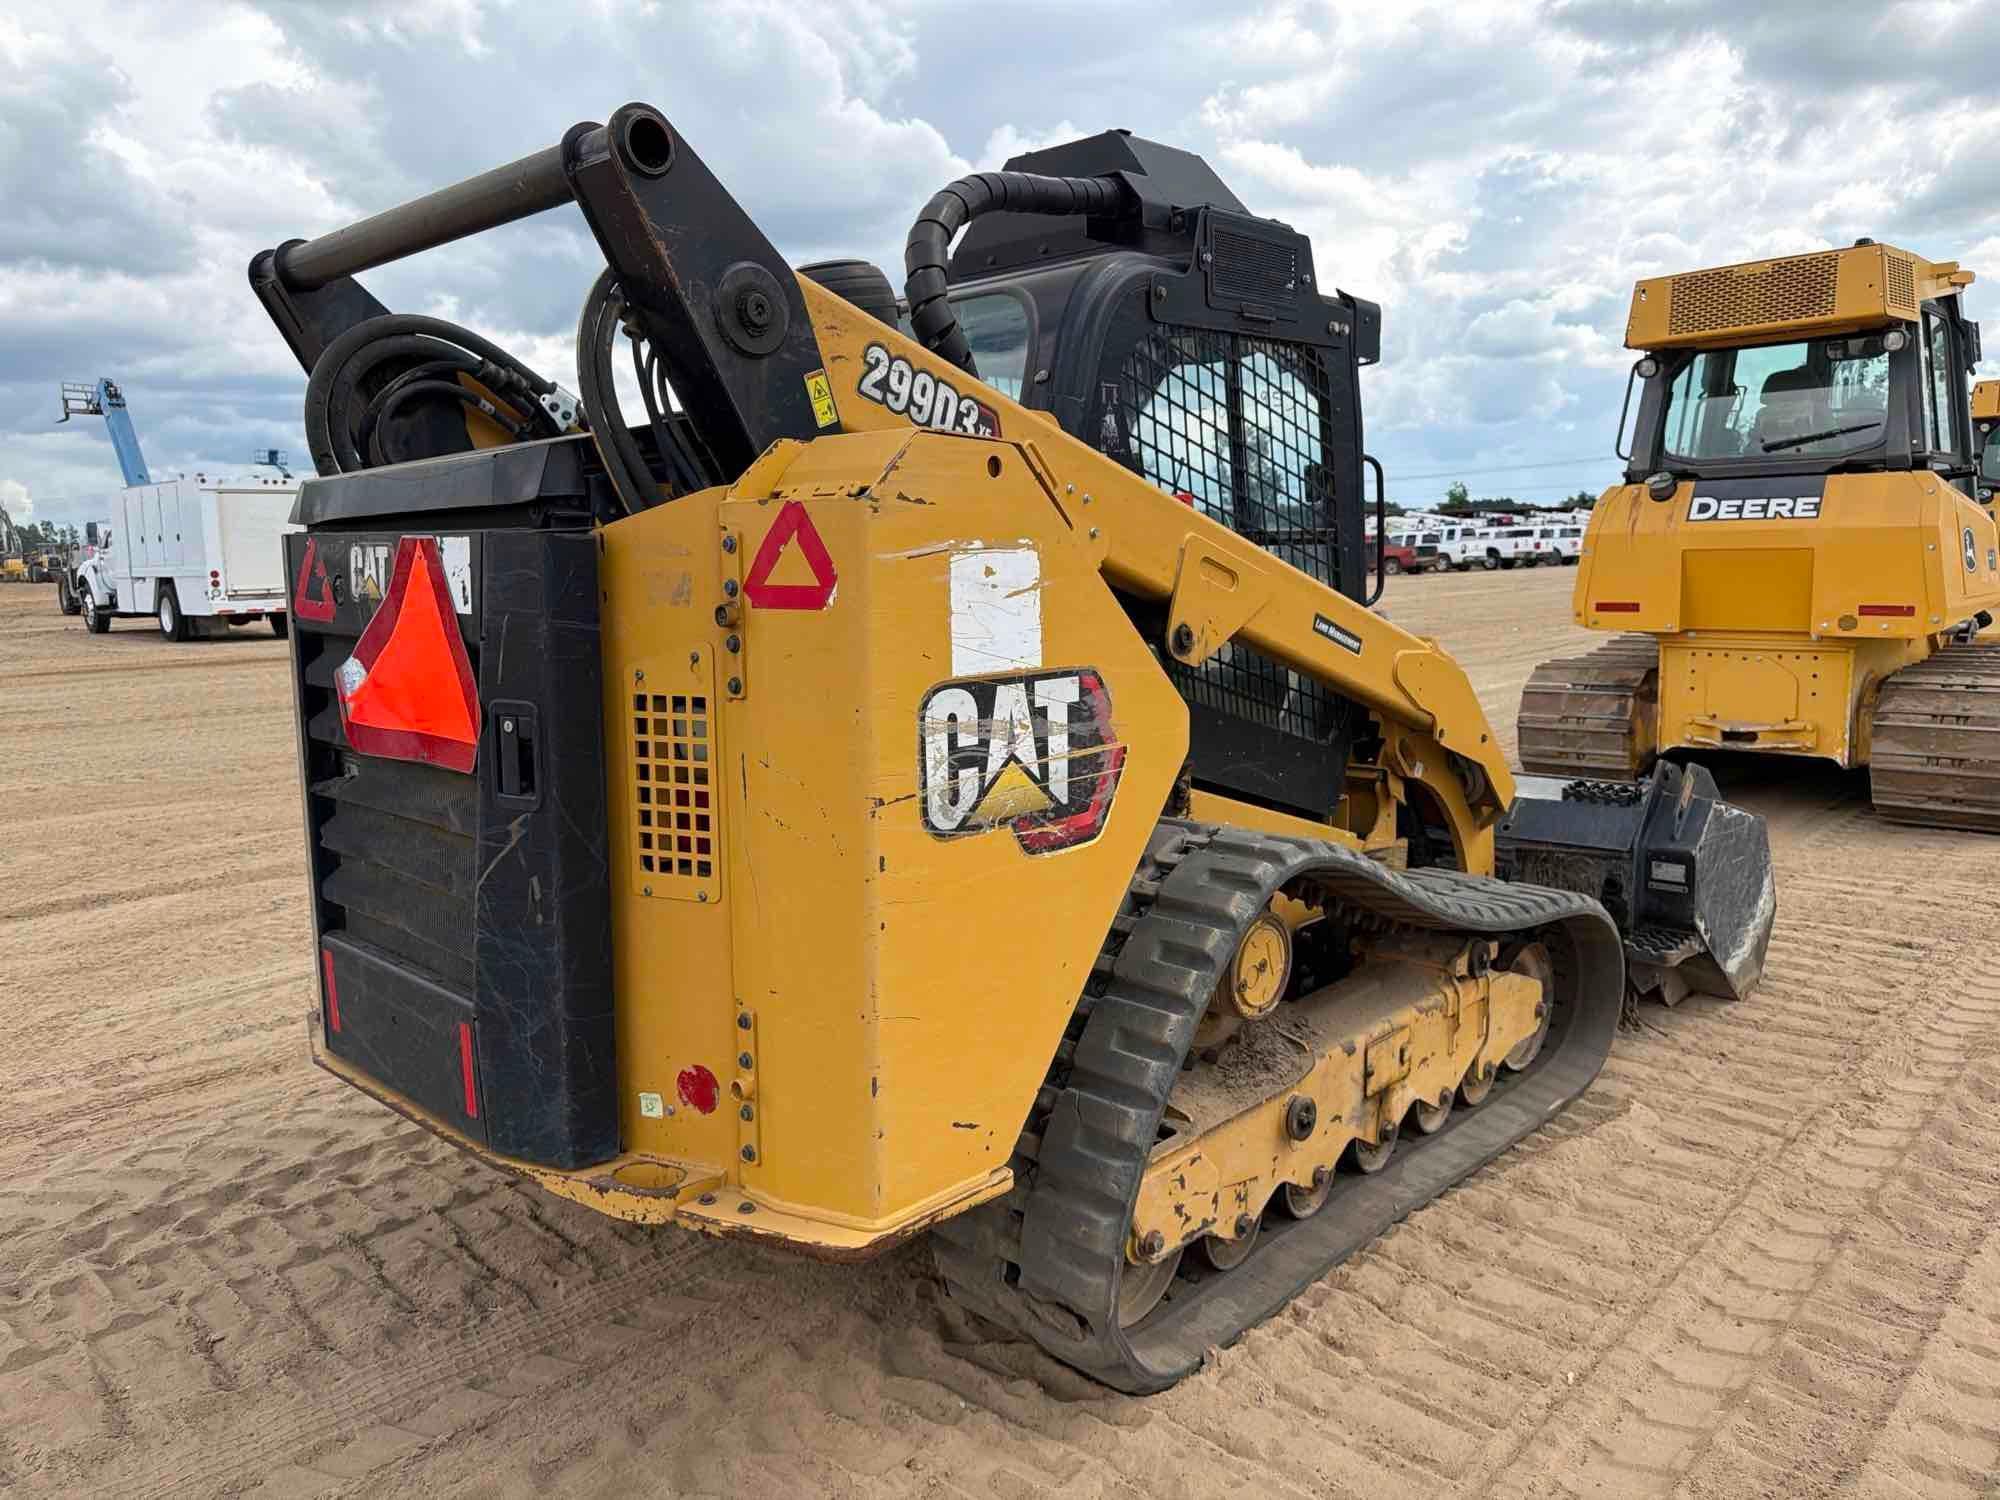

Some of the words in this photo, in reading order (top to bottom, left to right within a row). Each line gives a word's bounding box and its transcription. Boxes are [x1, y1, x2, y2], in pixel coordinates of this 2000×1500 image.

[859, 345, 979, 435] 299D3
[1688, 496, 1821, 521] DEERE
[350, 545, 389, 602] CAT
[924, 675, 1080, 831] CAT
